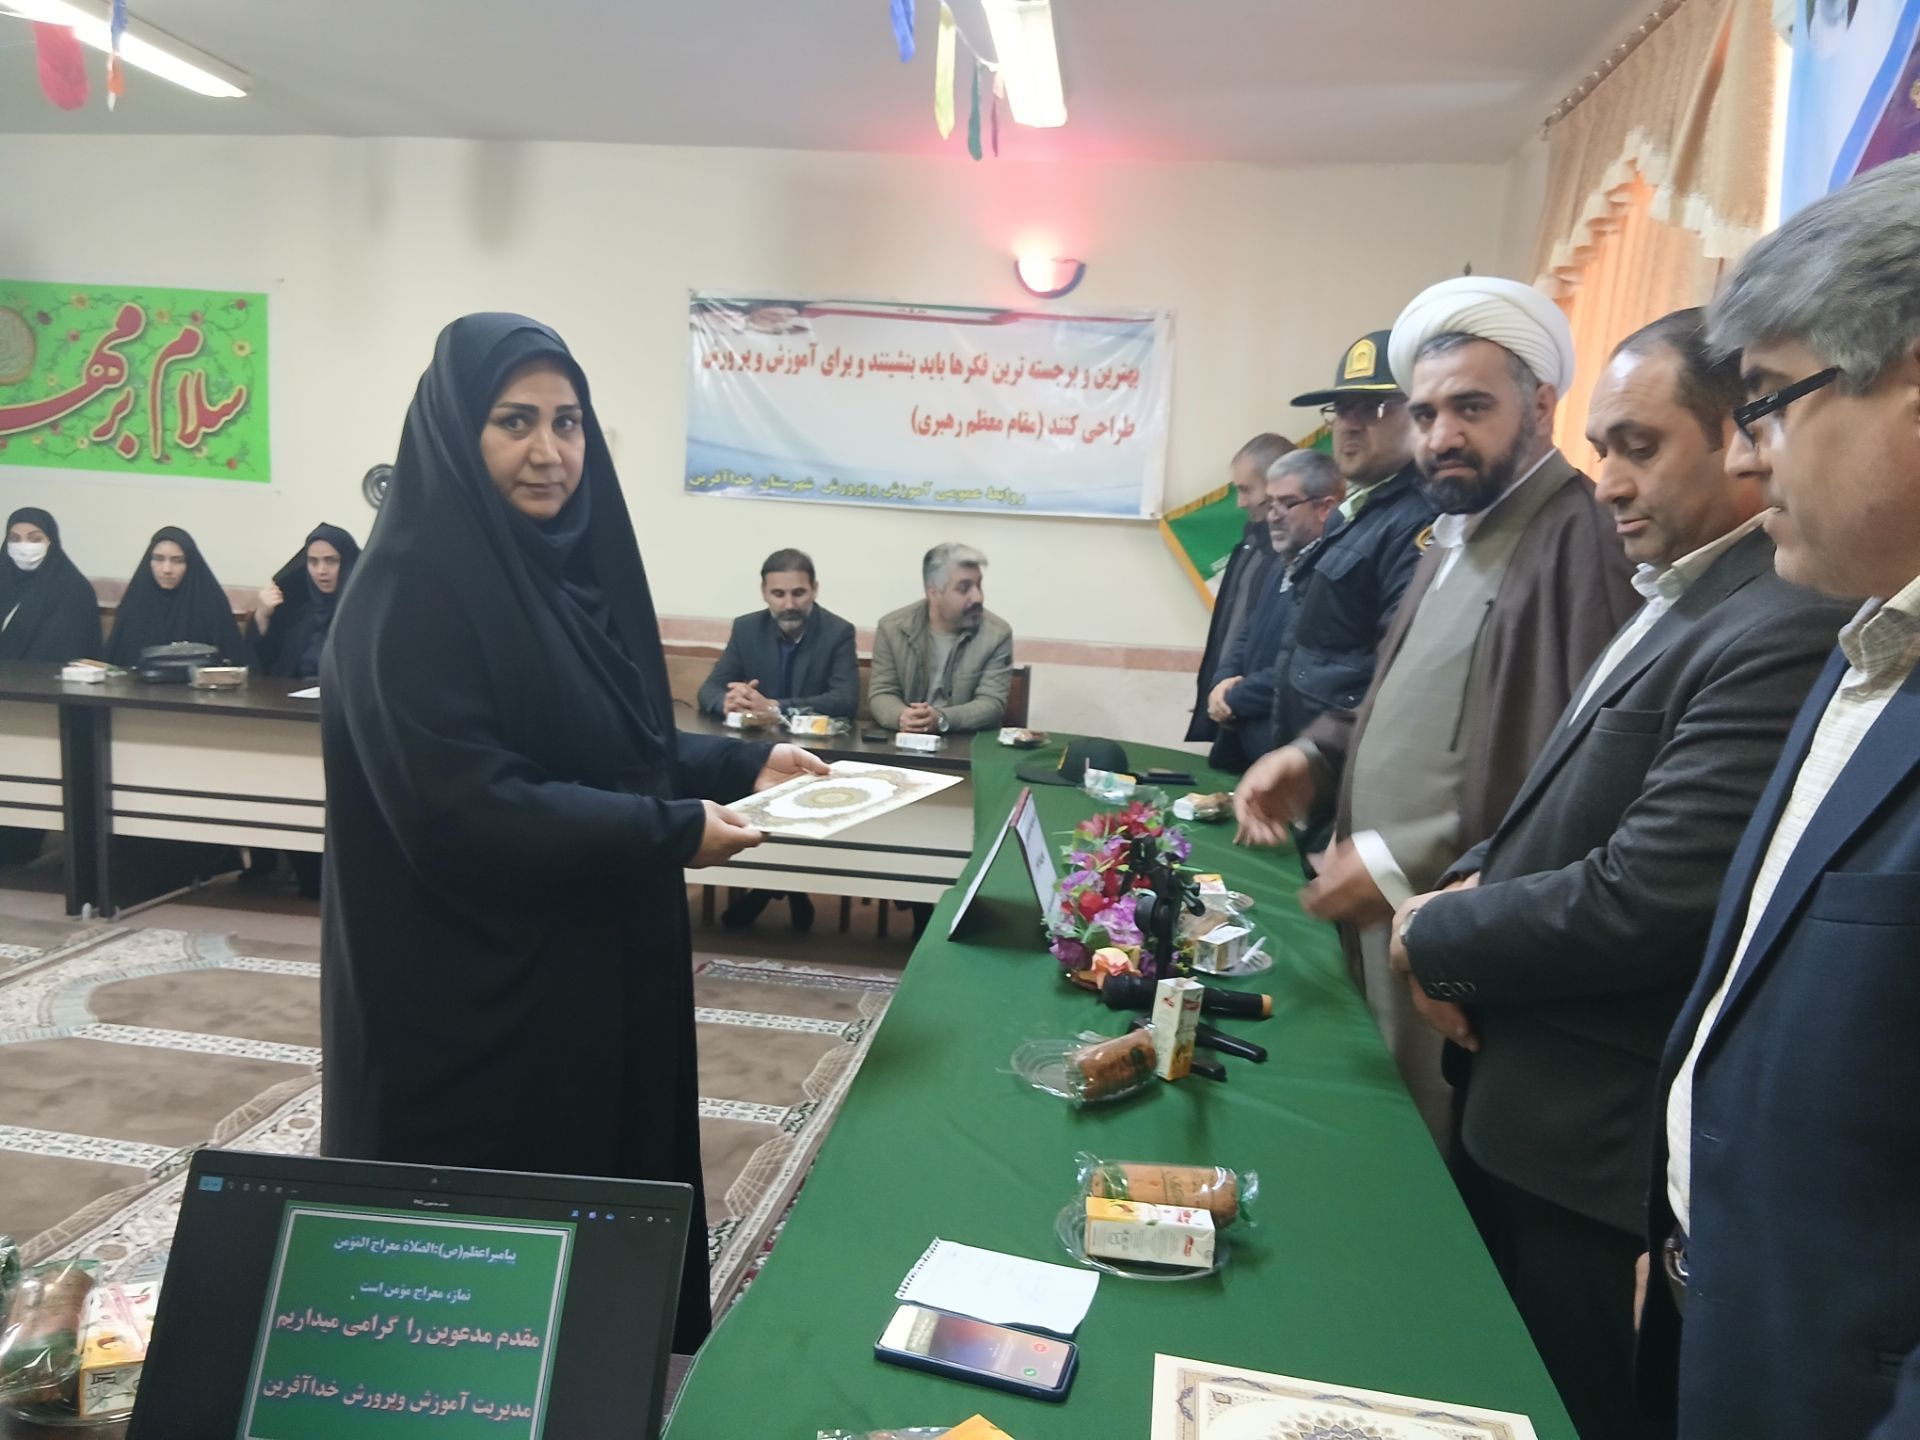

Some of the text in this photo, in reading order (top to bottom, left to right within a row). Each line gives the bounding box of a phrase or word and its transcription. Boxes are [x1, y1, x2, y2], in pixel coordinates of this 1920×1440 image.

[753, 351, 764, 374] و
[766, 343, 818, 376] آموزش
[820, 345, 854, 379] برای
[855, 356, 866, 379] و
[868, 350, 916, 380] بنشینند
[919, 351, 946, 381] باید
[1081, 367, 1090, 389] و
[910, 405, 1136, 446] طراحی کنند (مقام معظم رهبری)
[820, 477, 868, 498] پرورش
[880, 480, 934, 500] آموزش
[934, 485, 983, 503] عمومی
[412, 1285, 443, 1302] معراج
[275, 1307, 541, 1350] مقدم مدعوین را گرامی میداریم
[408, 1390, 470, 1416] آموزش
[471, 1397, 532, 1421] مدیریت
